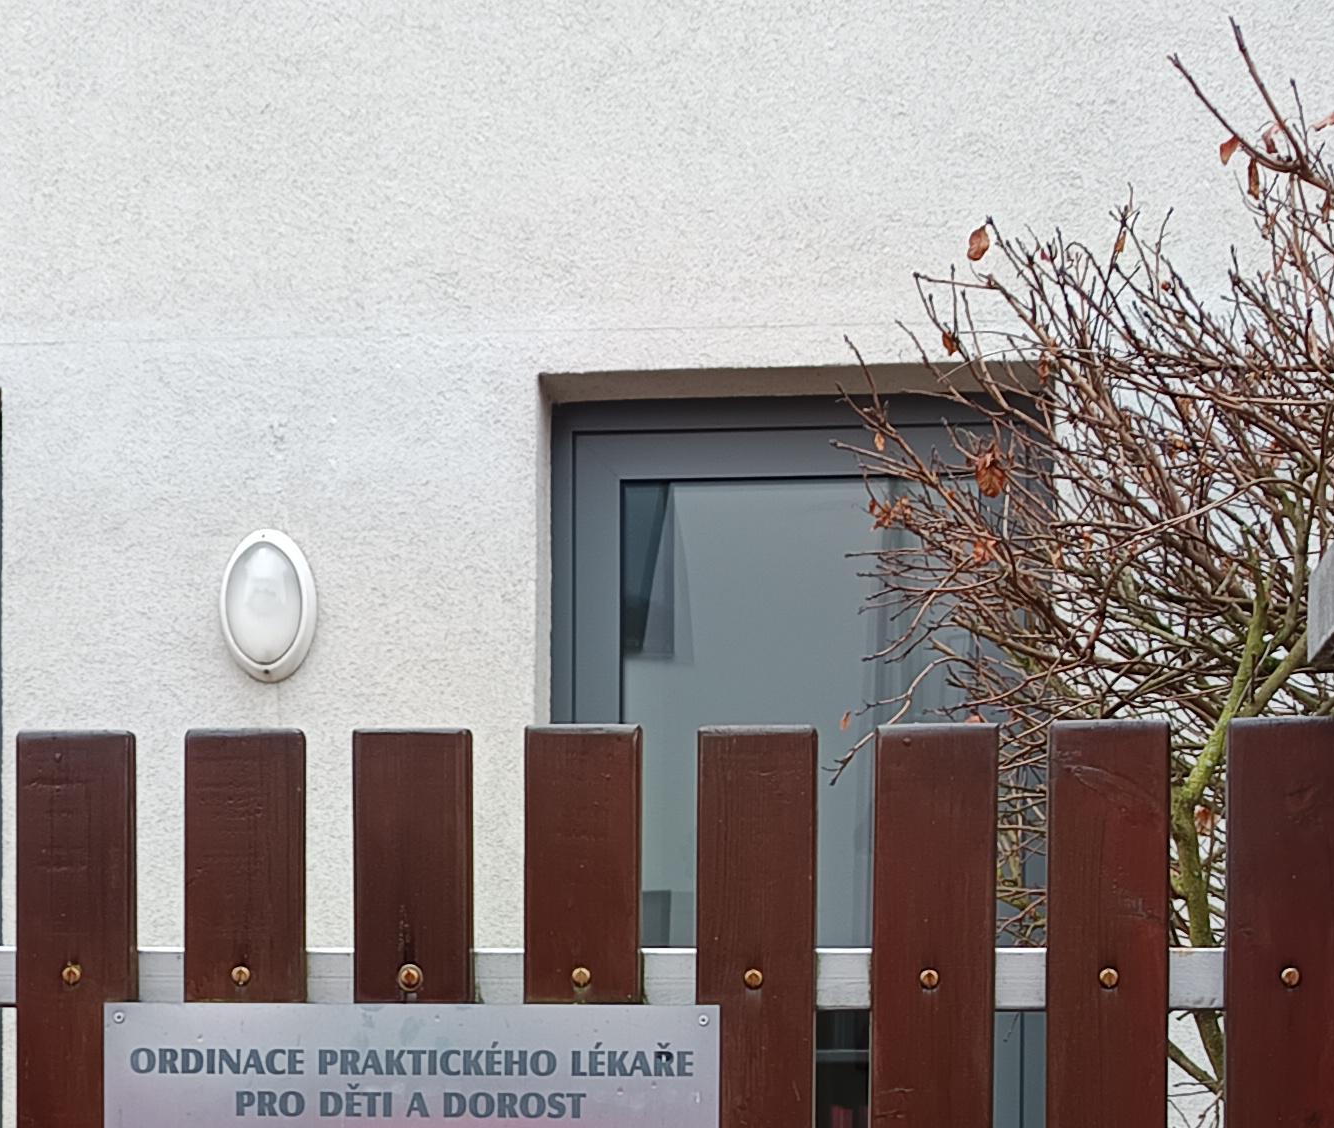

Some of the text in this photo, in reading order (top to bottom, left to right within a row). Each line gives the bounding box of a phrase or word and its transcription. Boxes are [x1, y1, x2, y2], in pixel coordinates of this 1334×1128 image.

[129, 1041, 694, 1078] ORDINACE PRAKTICKÉHO LÉKAŘE
[235, 1083, 588, 1120] PRO DĚTI A DOROST
